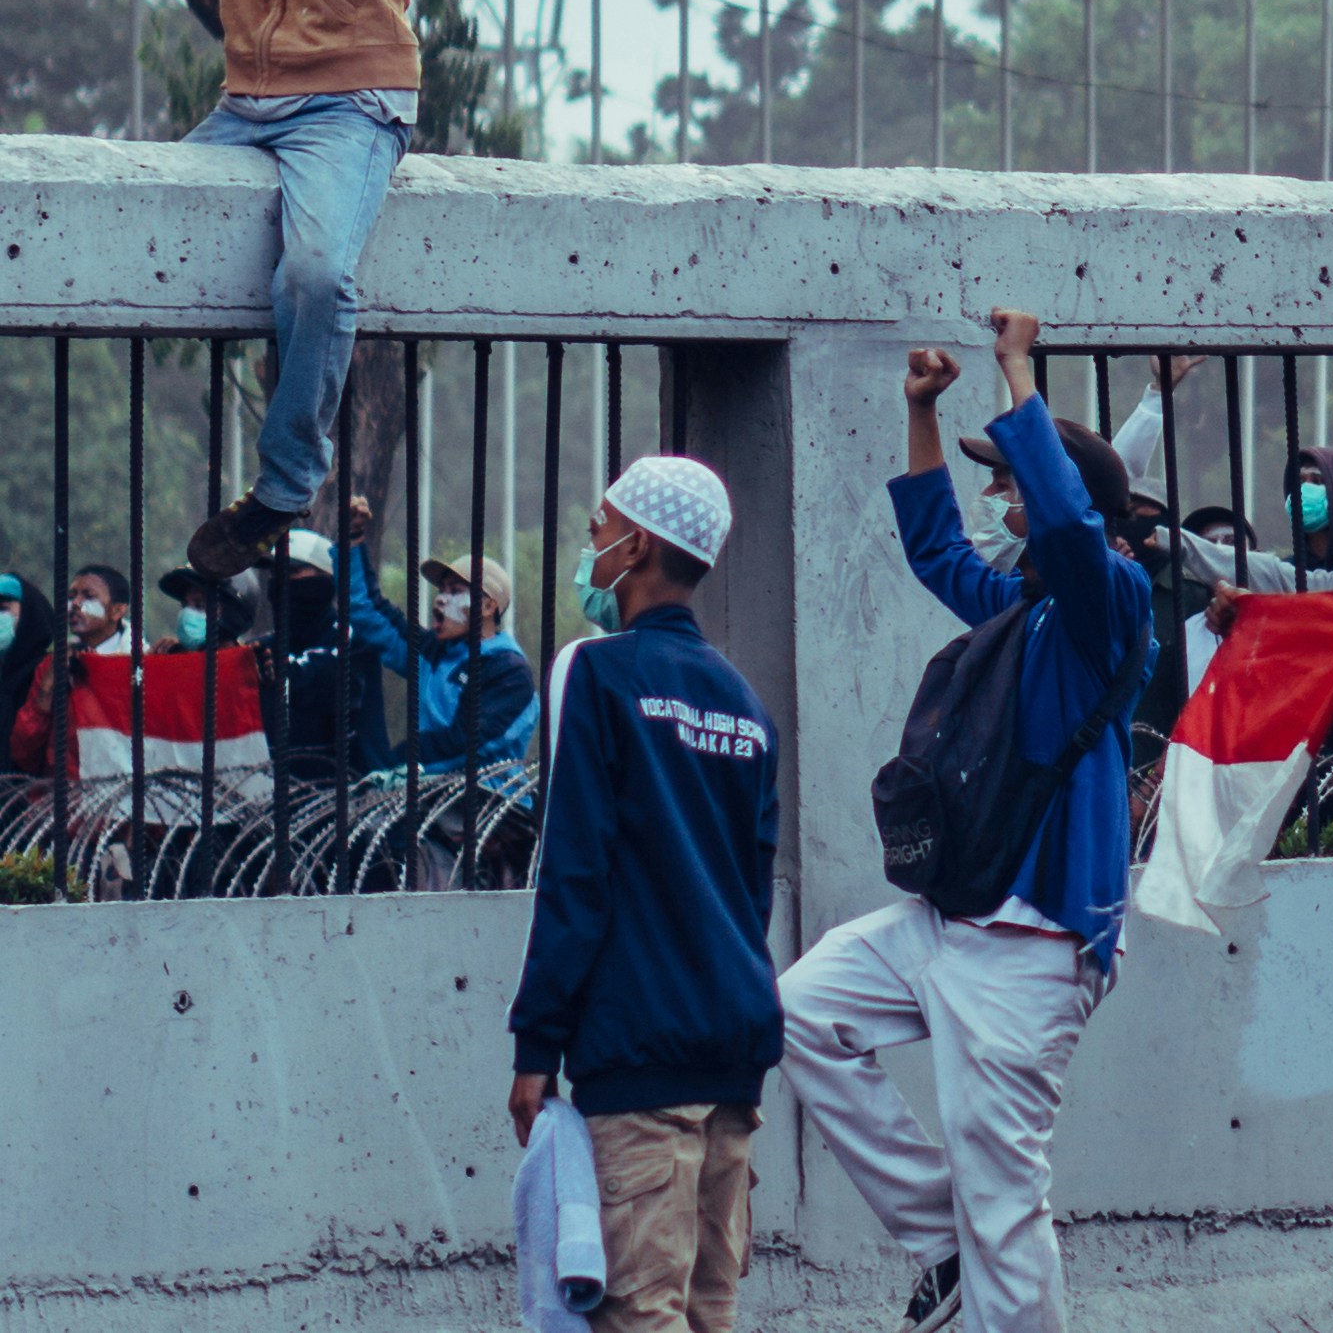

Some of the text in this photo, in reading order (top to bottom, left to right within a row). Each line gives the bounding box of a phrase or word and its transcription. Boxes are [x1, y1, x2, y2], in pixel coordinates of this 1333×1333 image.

[704, 711, 735, 734] HIGH
[737, 718, 767, 753] SCHO
[735, 738, 753, 757] 23
